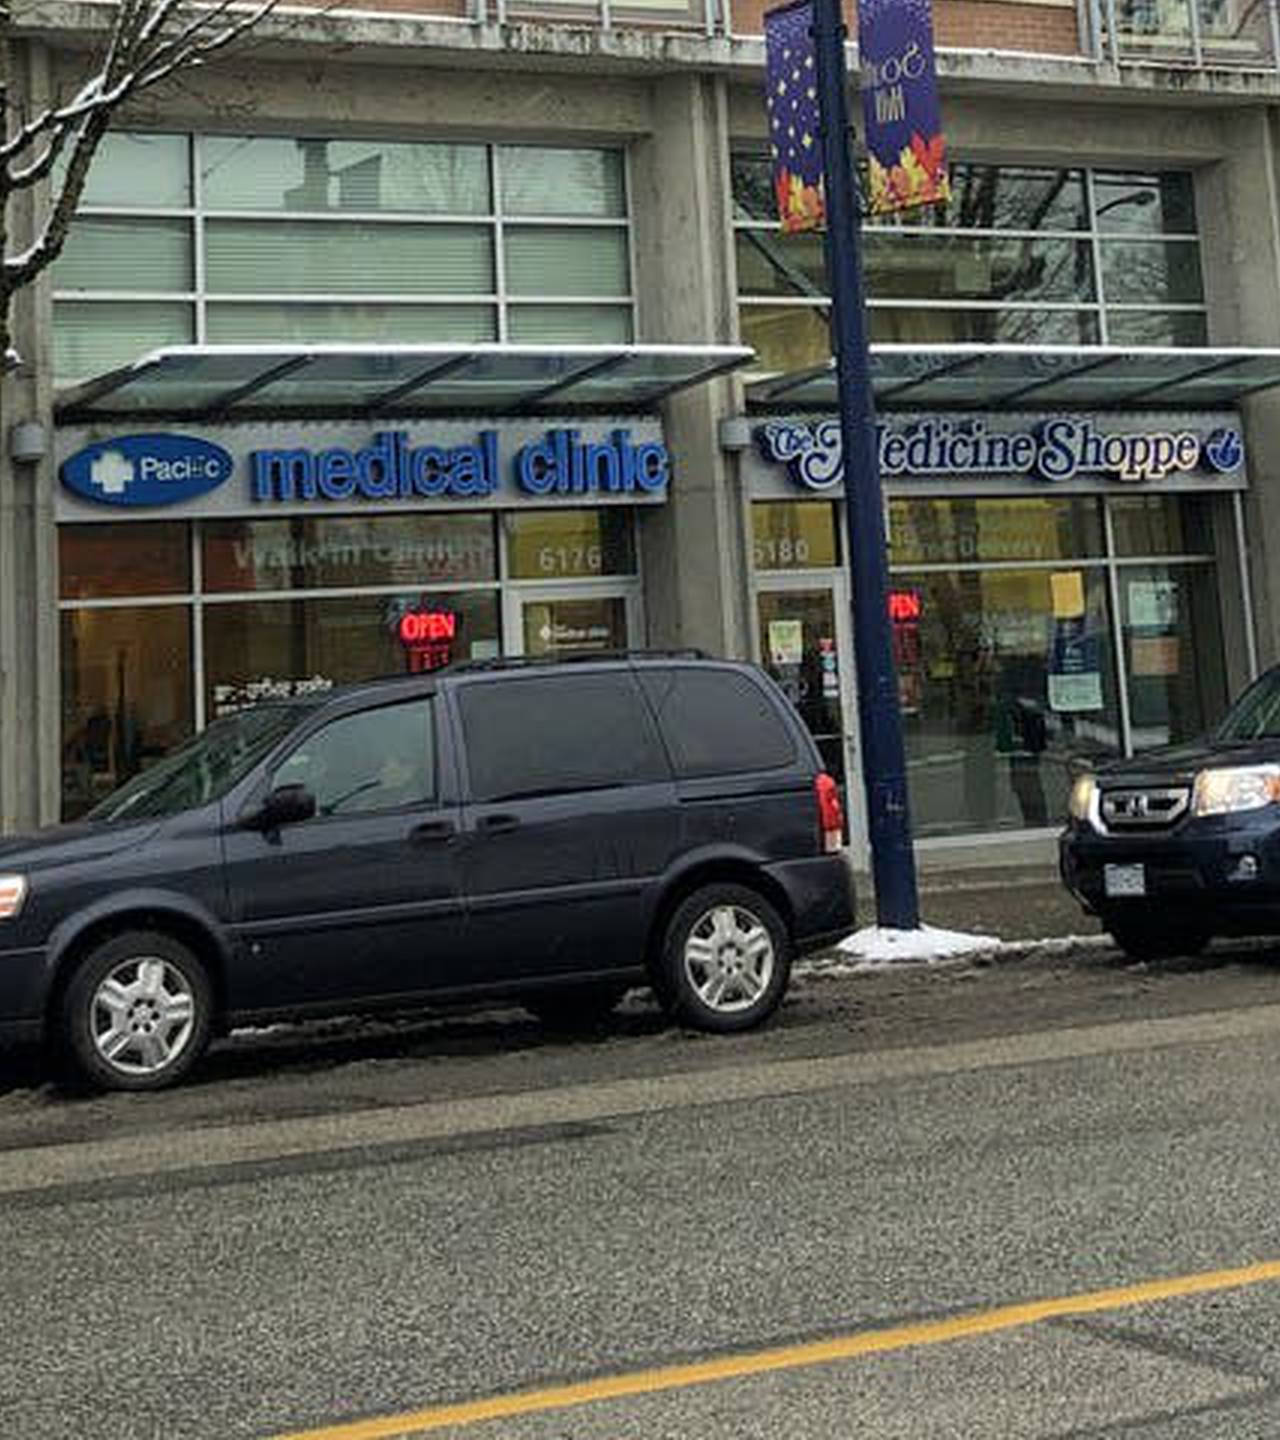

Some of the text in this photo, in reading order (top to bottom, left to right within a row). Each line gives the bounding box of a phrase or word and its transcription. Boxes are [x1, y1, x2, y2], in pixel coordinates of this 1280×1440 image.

[252, 430, 497, 502] medical
[517, 428, 670, 494] clinic
[1038, 420, 1199, 482] Shoppe
[401, 612, 455, 642] OPEN
